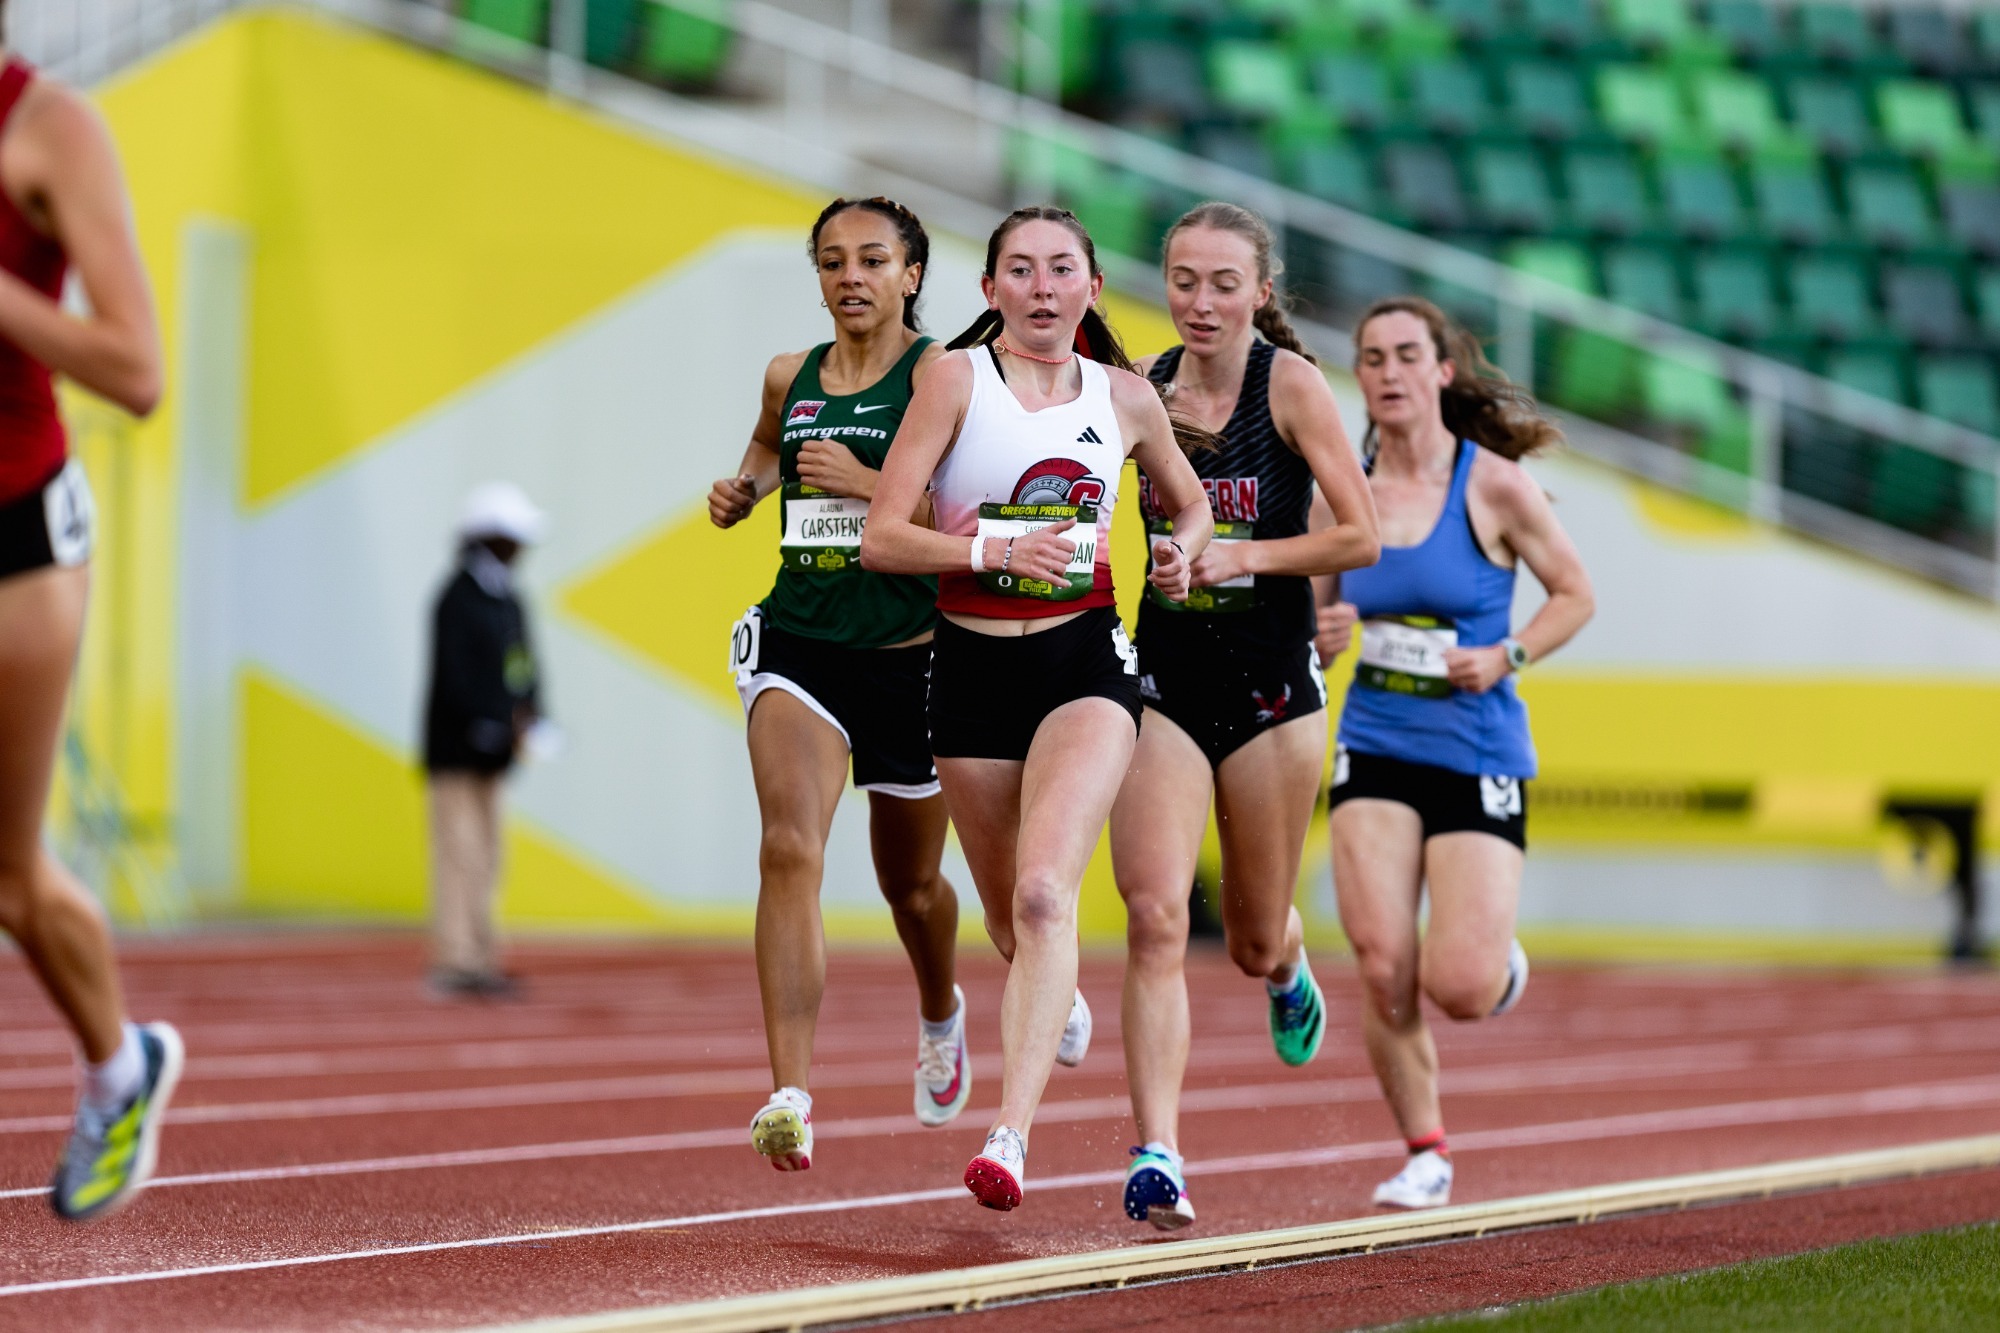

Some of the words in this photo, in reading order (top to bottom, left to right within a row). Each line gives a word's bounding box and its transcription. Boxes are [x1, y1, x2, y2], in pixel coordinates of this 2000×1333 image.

[783, 426, 887, 442] evergreen
[1139, 477, 1259, 520] EAERN
[819, 503, 844, 513] ALAUNA
[1000, 505, 1037, 516] OREGON
[1038, 506, 1079, 517] PREVIEW
[998, 575, 1012, 588] O
[732, 623, 753, 666] 10
